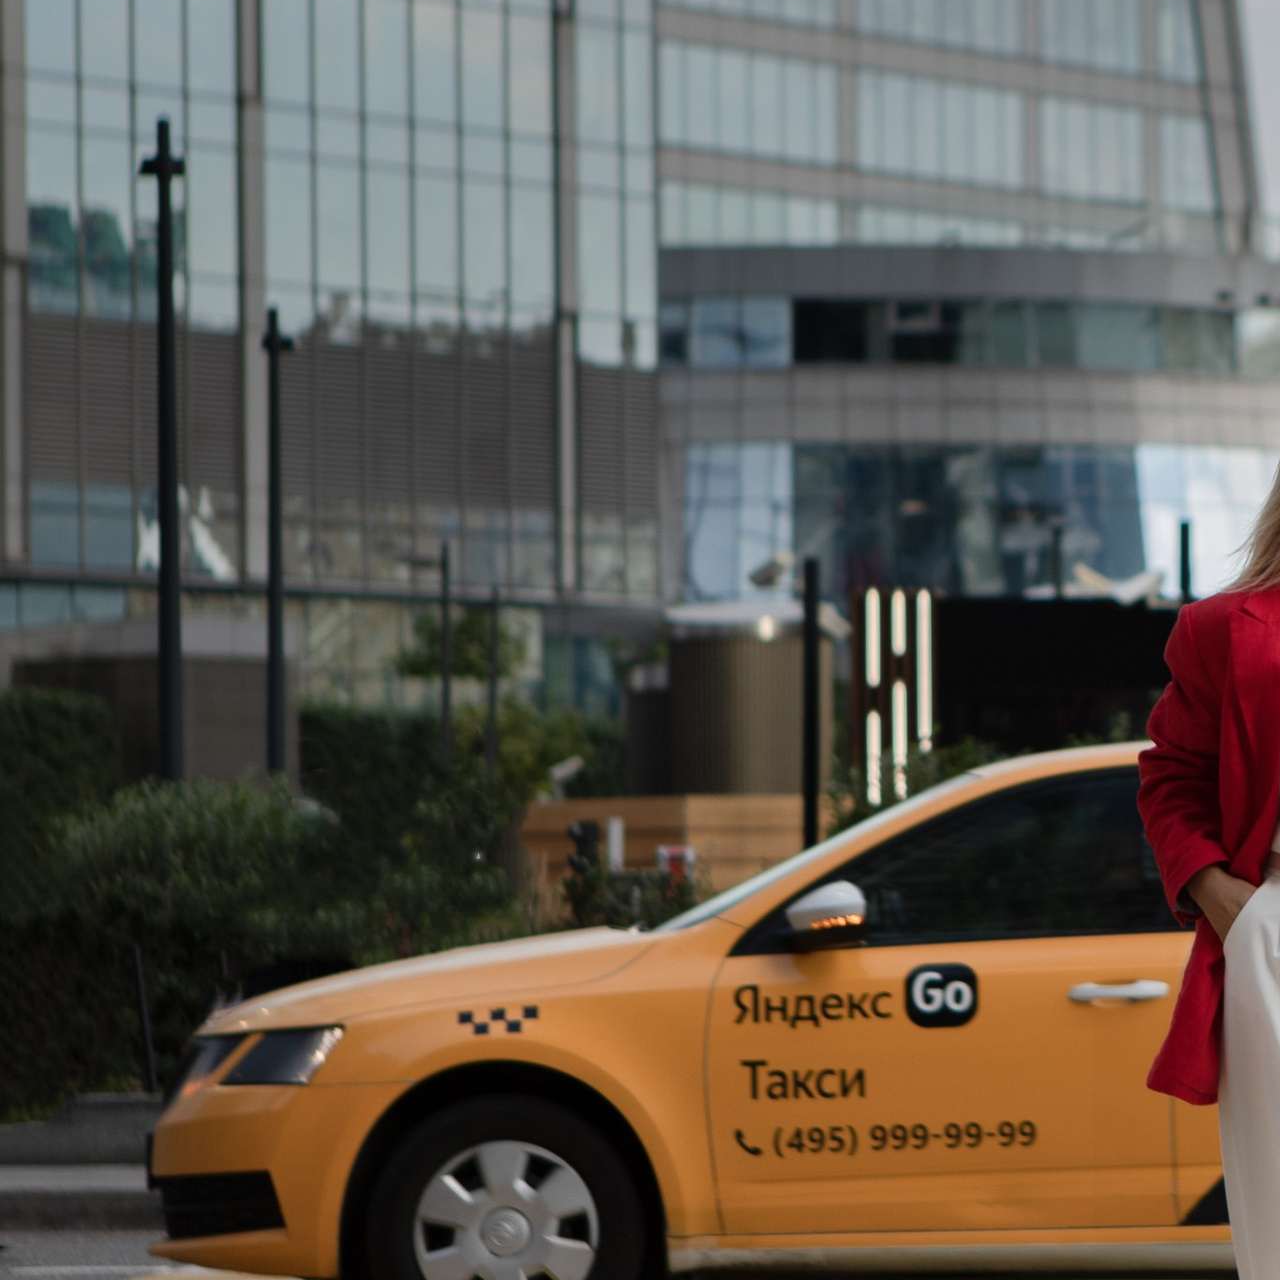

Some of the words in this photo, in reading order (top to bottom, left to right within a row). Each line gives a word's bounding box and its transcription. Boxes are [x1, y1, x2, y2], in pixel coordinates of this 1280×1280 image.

[734, 985, 894, 1027] Яндекс
[911, 970, 974, 1014] Go
[741, 1060, 867, 1100] Такси
[773, 1125, 859, 1158] (495)
[870, 1121, 1037, 1152] 999-99-99
